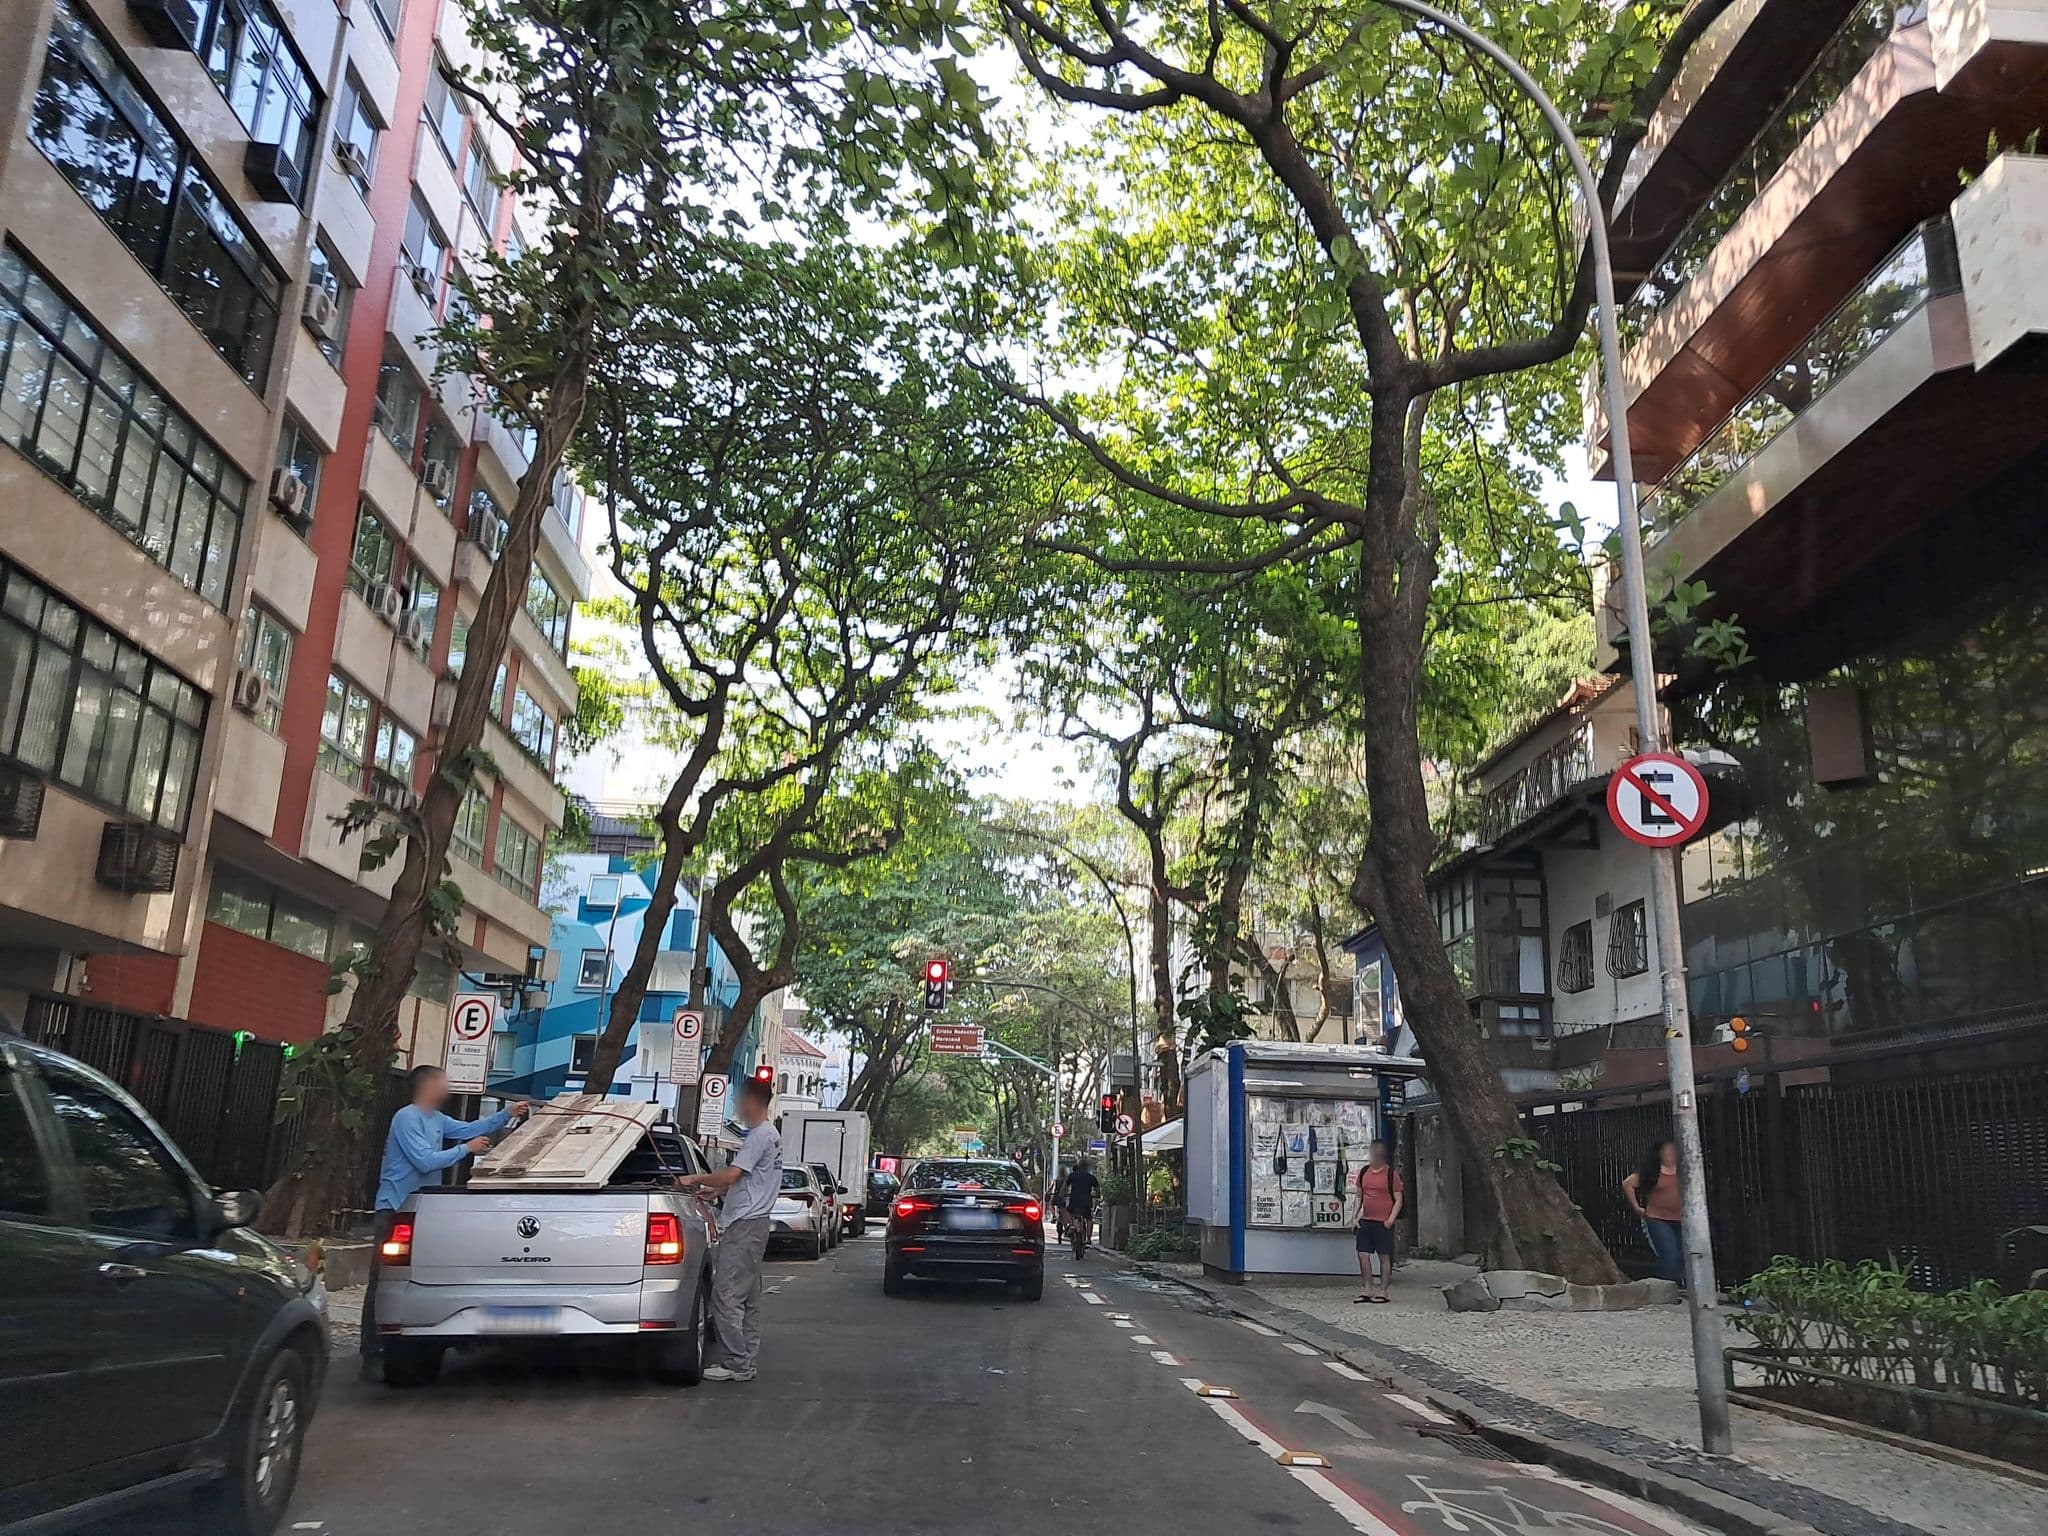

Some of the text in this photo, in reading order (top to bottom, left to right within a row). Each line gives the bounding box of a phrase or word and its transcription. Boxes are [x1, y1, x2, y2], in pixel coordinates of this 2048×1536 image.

[1639, 773, 1676, 825] E
[464, 1007, 480, 1031] E
[683, 1019, 694, 1034] E
[711, 1081, 720, 1094] E
[1318, 1202, 1325, 1212] I
[1316, 1212, 1342, 1223] RIO
